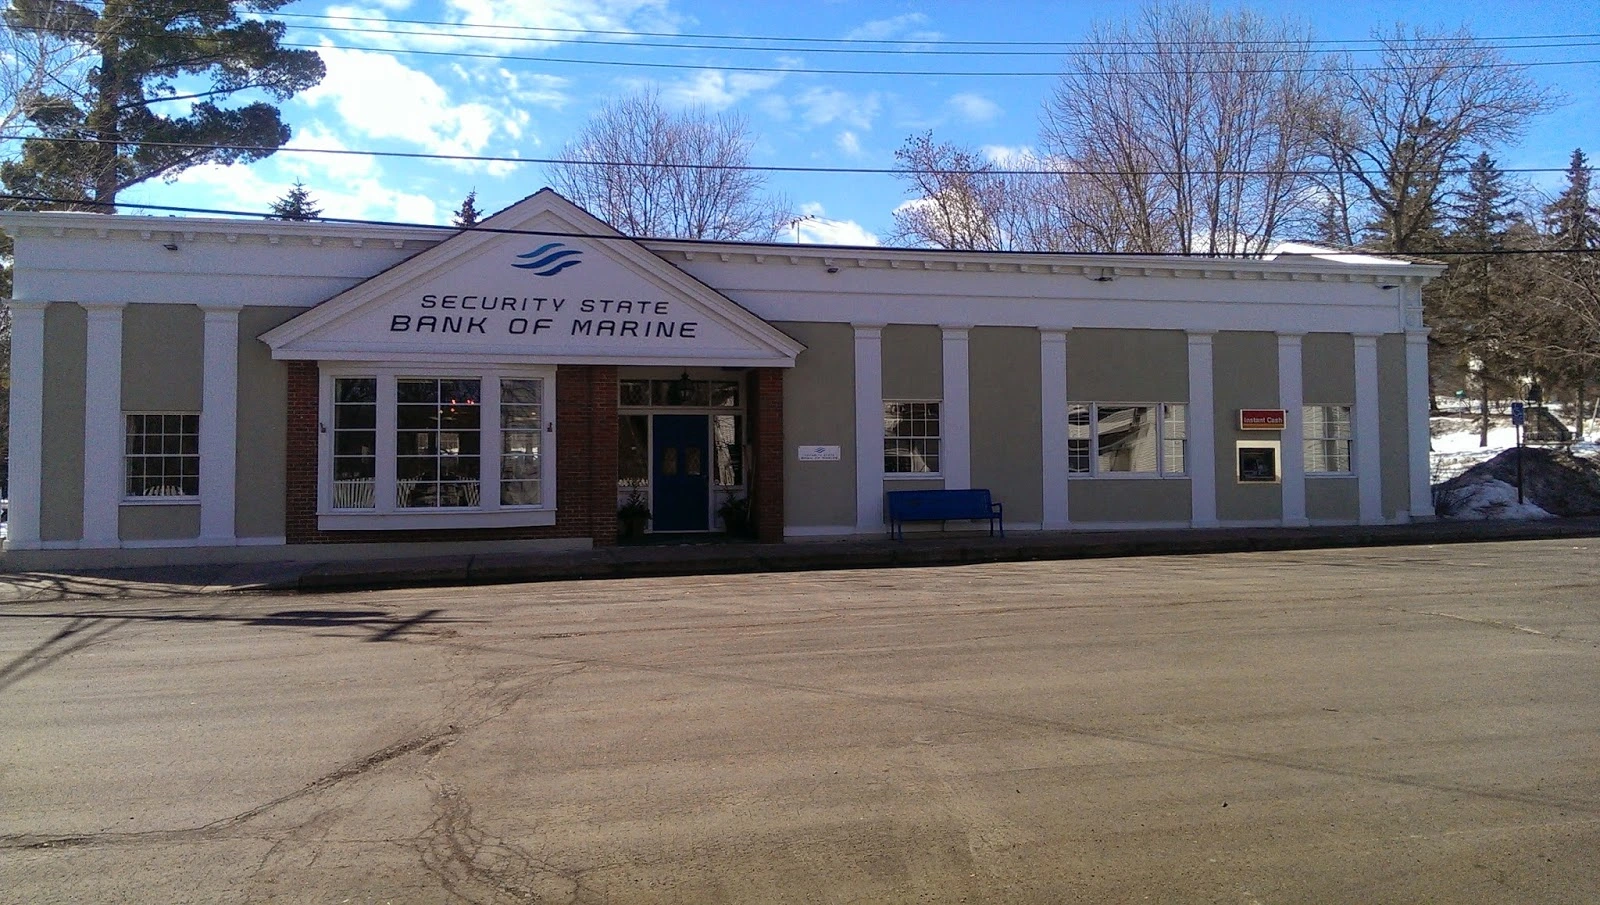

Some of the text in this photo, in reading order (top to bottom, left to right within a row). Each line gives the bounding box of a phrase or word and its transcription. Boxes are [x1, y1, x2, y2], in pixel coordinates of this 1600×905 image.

[421, 295, 670, 314] SECURITY STATE
[390, 315, 698, 338] BANK OF MARINE
